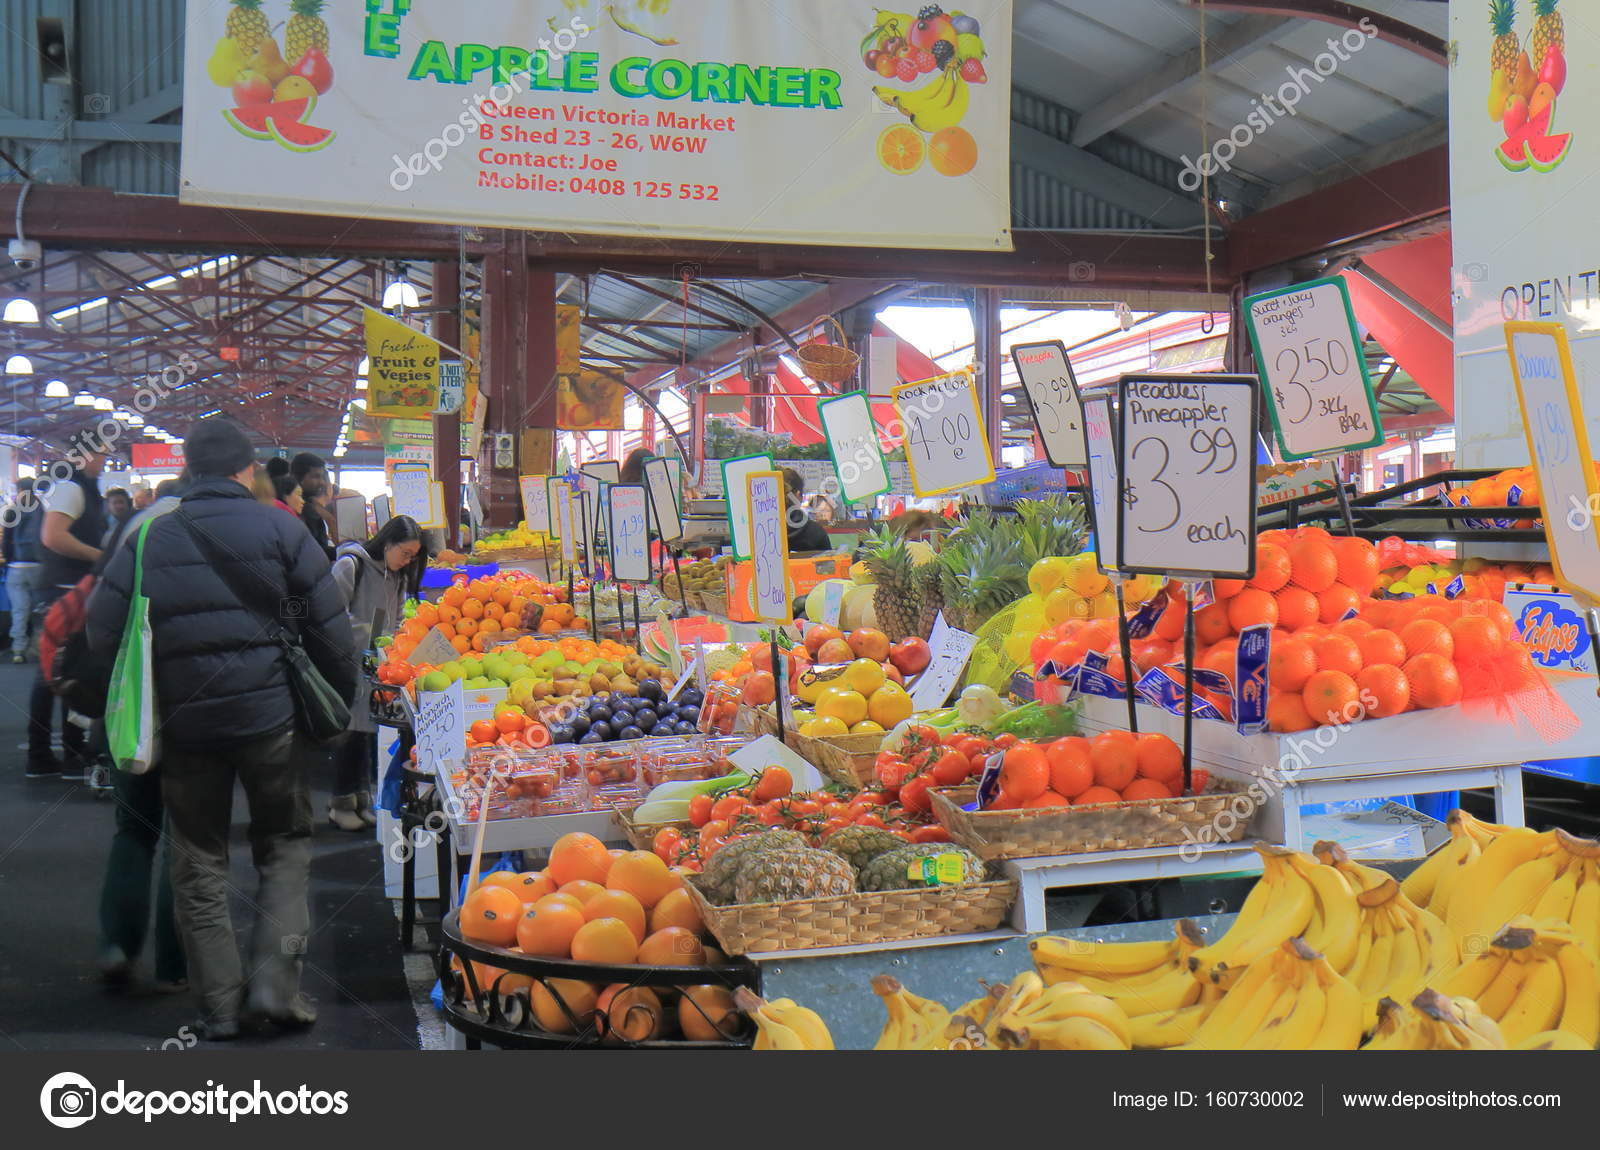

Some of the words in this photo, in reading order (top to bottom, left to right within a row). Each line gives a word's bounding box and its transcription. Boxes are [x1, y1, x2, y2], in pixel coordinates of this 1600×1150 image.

[408, 41, 599, 94] APPLE
[609, 56, 842, 110] CORNER
[479, 99, 555, 121] Queen
[561, 104, 651, 126] Victoria
[656, 110, 735, 132] Market
[479, 123, 494, 140] B
[501, 125, 557, 146] Shed
[563, 129, 592, 146] 23
[611, 131, 644, 154] 26,
[649, 134, 708, 154] W6W
[478, 147, 575, 170] Contact:
[578, 153, 617, 173] Joe
[478, 171, 565, 193] Mobile:
[568, 177, 626, 197] 0408
[633, 180, 672, 199] 125
[679, 182, 720, 202] 532
[1501, 274, 1571, 321] OPEN
[1578, 270, 1600, 310] T
[372, 356, 416, 368] Fruit
[423, 356, 437, 368] &
[378, 369, 432, 384] Vegies
[910, 412, 970, 460] 4.00
[1187, 515, 1246, 545] each
[1522, 606, 1579, 663] Eclipse
